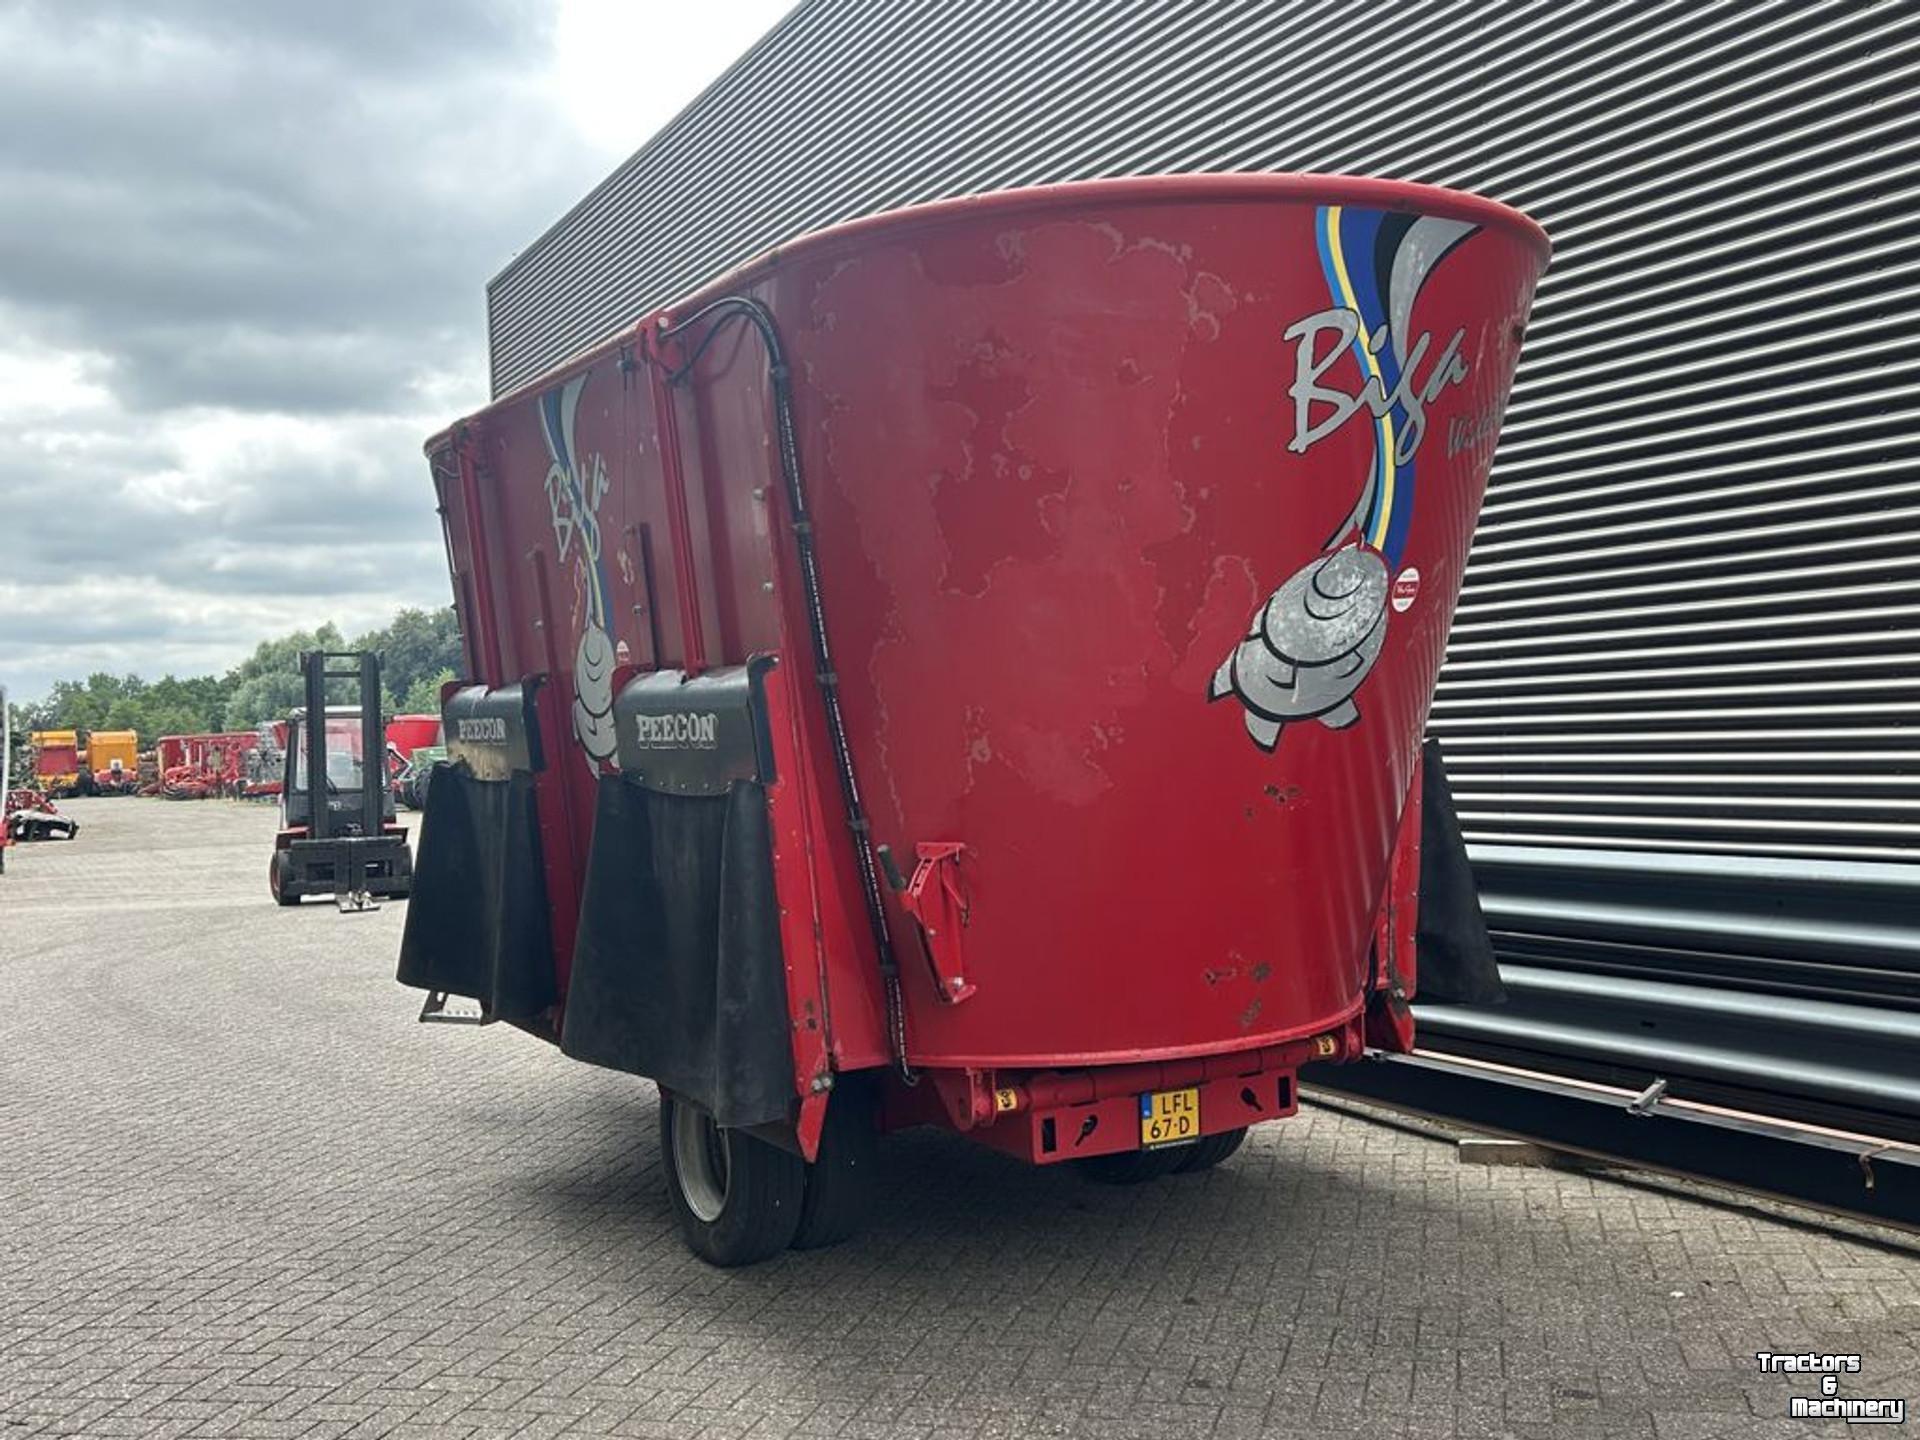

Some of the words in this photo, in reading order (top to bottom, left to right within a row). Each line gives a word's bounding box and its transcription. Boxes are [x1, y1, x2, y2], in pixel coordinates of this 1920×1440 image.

[1283, 306, 1469, 467] Biga
[457, 717, 507, 744] PEECON
[635, 712, 719, 749] PEECON
[1162, 1092, 1193, 1115] LFL
